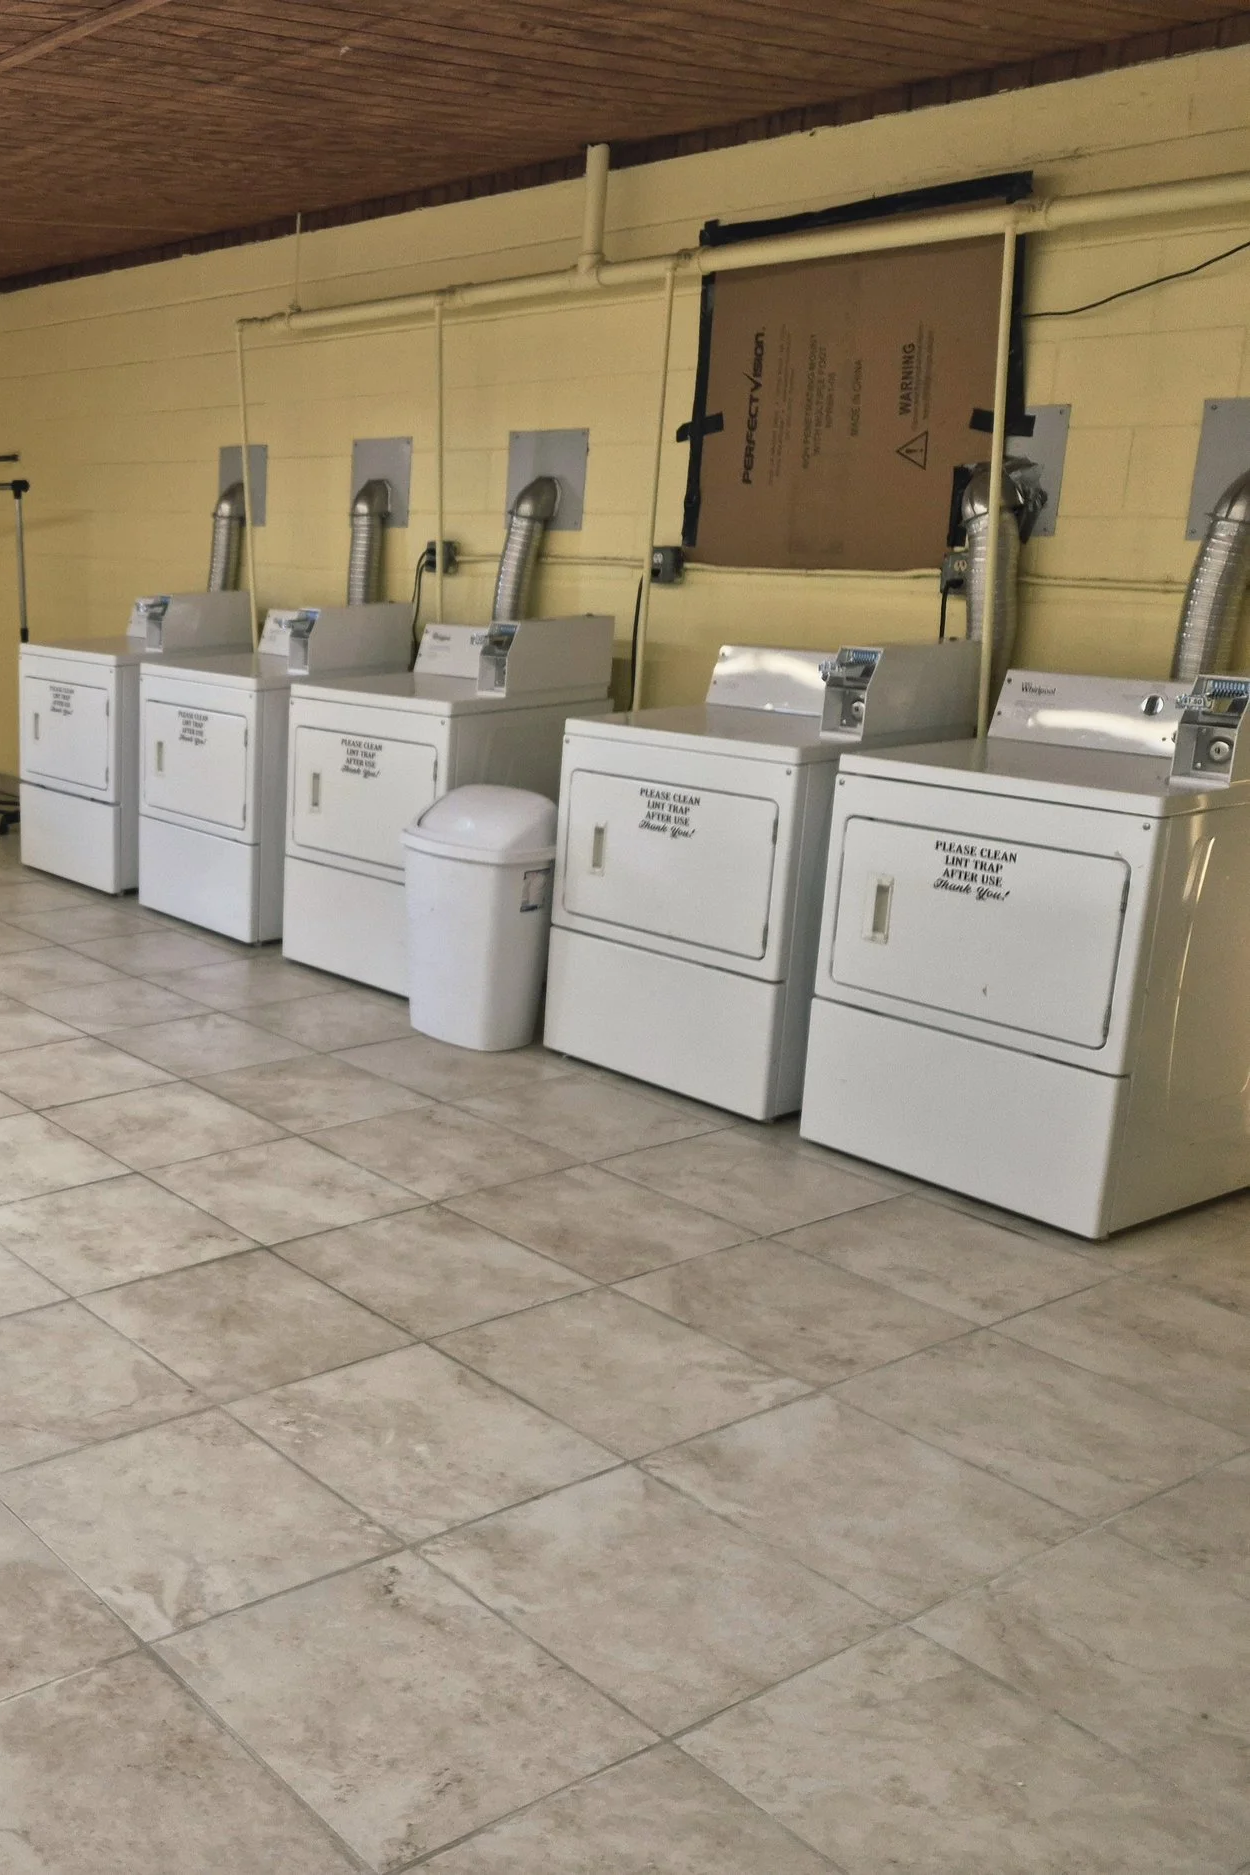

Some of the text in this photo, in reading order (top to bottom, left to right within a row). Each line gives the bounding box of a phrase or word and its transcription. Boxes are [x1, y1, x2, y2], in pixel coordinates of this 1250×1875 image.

[853, 358, 862, 392] CHINA
[899, 342, 915, 416] WARNING
[851, 407, 861, 437] MADE
[1021, 681, 1057, 696] Whirlpool
[341, 739, 382, 751] PLEASE CLEAN
[346, 748, 376, 759] LINT TRAP
[346, 758, 376, 768] AFTER USE
[640, 788, 700, 806] PLEASE CLEAN
[647, 800, 690, 815] LINT TRAP
[645, 811, 690, 827] AFTER USE
[639, 820, 695, 838] Thank You!
[935, 840, 1017, 863] PLEASE CLEAN
[945, 855, 1003, 873] LINT TRAP
[943, 868, 1002, 887] AFTER USE
[933, 878, 1010, 901] Thank You!
